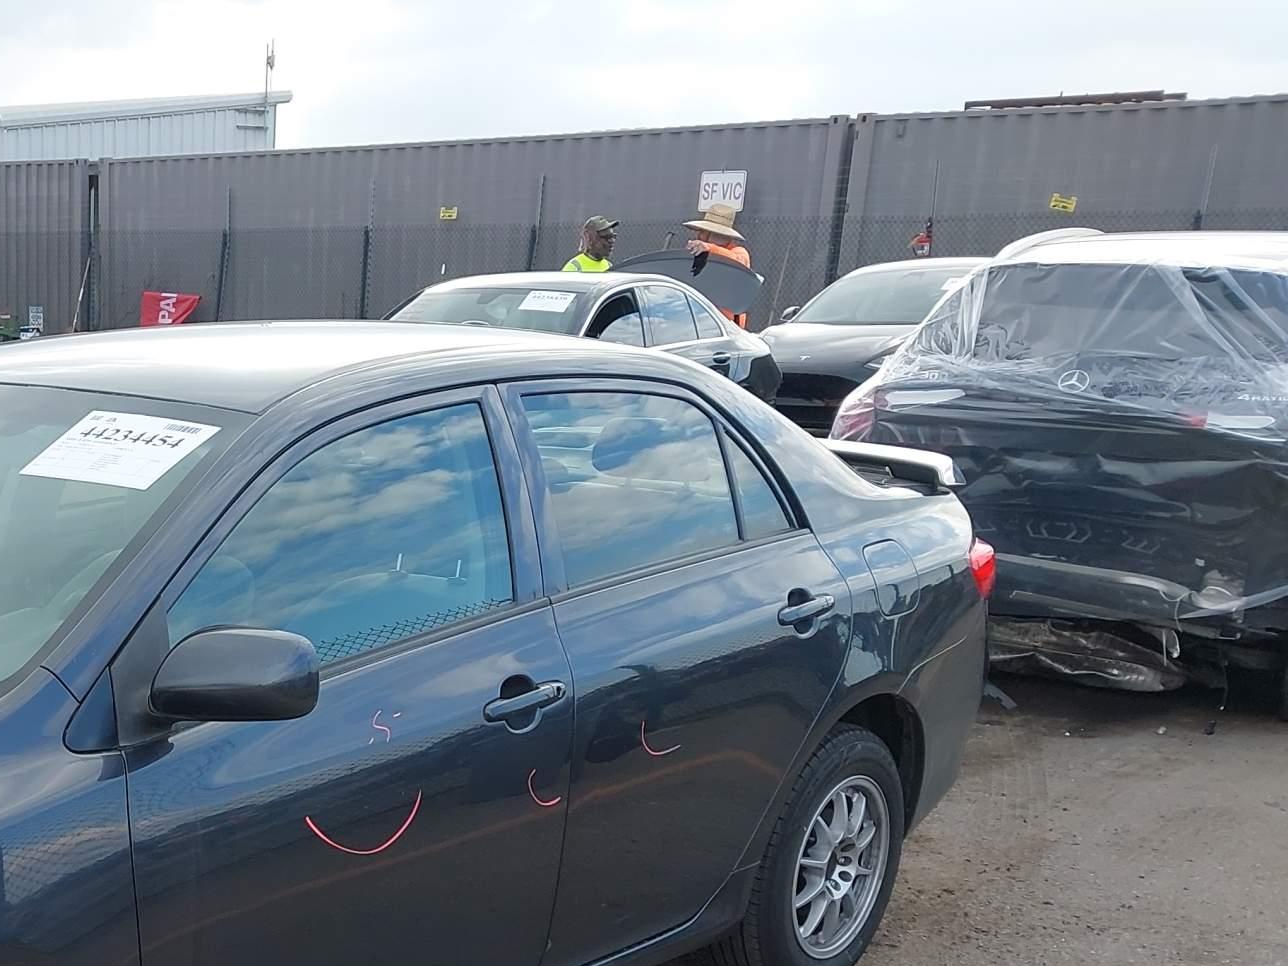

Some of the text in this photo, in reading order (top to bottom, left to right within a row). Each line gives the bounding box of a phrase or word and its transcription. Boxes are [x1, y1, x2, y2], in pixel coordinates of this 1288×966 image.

[702, 182, 743, 200] SF VIC
[79, 425, 186, 449] 44234454
